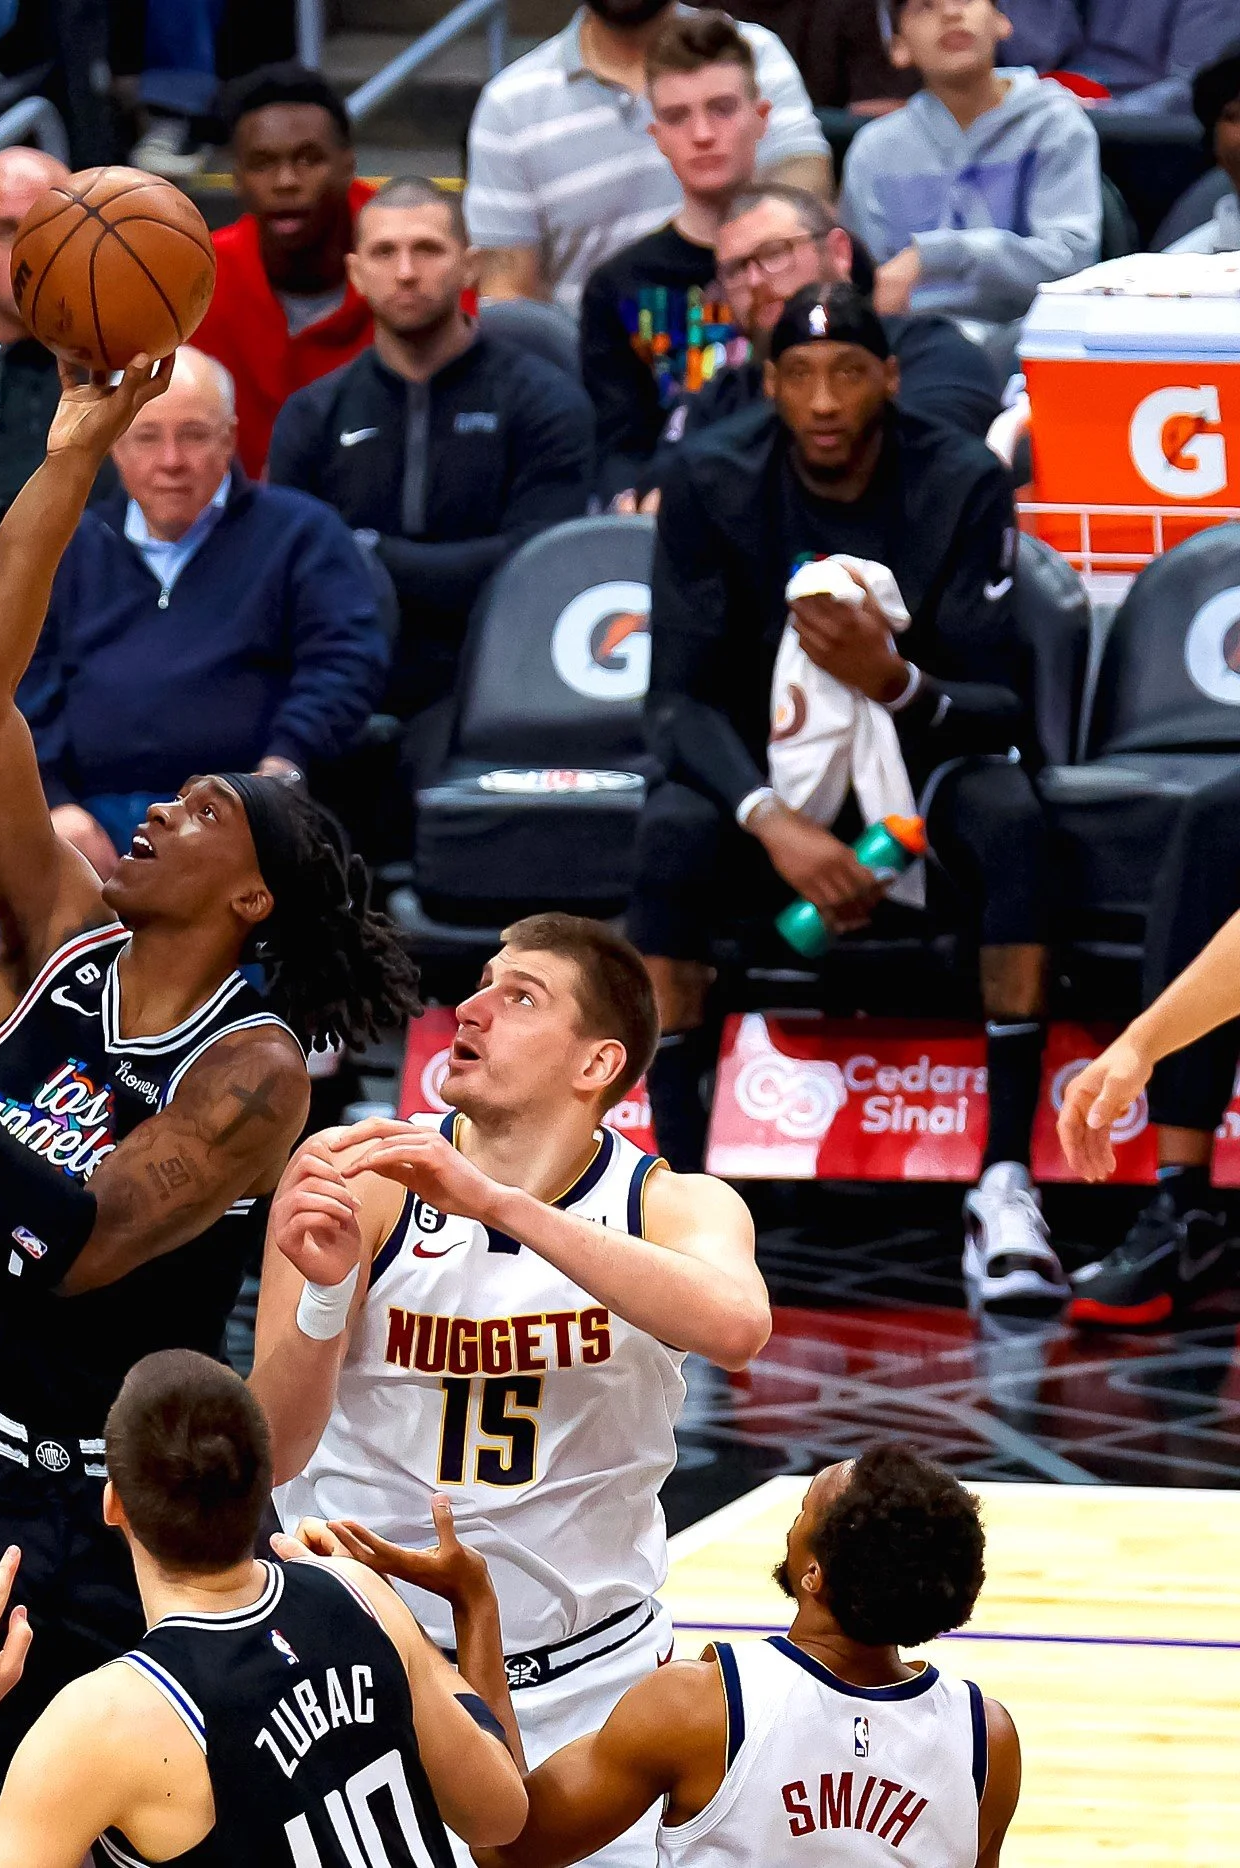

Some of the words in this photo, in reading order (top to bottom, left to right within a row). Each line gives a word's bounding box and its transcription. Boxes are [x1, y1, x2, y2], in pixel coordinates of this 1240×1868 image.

[1129, 384, 1228, 498] G
[550, 580, 652, 701] G
[75, 962, 101, 985] 6
[114, 1059, 160, 1105] honey
[861, 1095, 969, 1135] Sinai
[418, 1205, 439, 1231] 6
[384, 1305, 613, 1376] NUGGETS
[436, 1376, 545, 1490] 15
[254, 1664, 375, 1779] ZUBAC
[780, 1771, 930, 1849] SMITH
